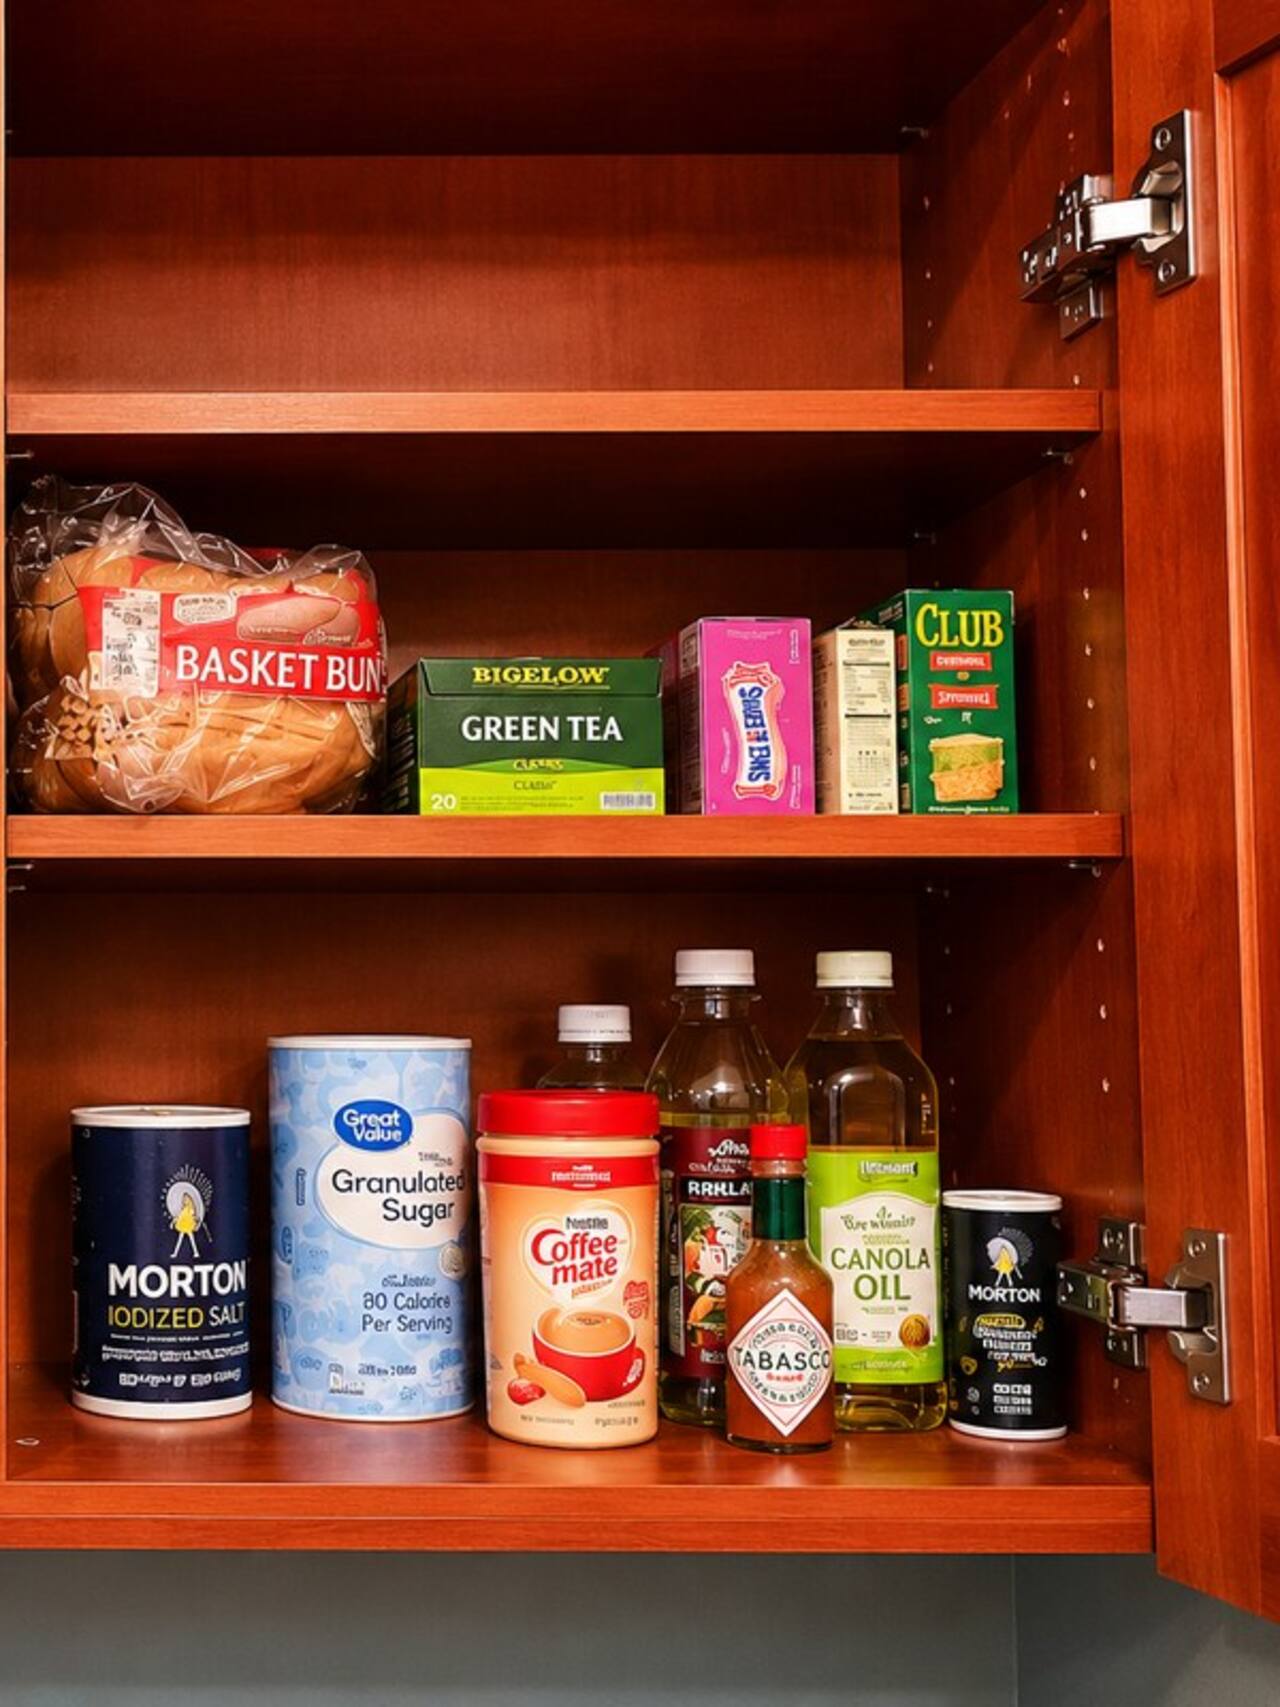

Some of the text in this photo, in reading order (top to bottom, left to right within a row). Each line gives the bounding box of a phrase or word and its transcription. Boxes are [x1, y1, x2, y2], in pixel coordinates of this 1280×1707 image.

[916, 603, 1004, 647] CLUB
[176, 645, 387, 694] BASKET BUN
[473, 667, 604, 685] BIGELOW
[461, 716, 622, 741] GREEN TEA
[431, 794, 457, 811] 20
[343, 1109, 400, 1127] Great
[353, 1125, 402, 1142] Value
[331, 1168, 465, 1194] Granulated
[382, 1197, 455, 1228] Sugar
[531, 1228, 617, 1266] Coffee
[831, 1248, 931, 1270] CANOLA
[108, 1259, 246, 1299] MORTON
[552, 1256, 617, 1286] mate
[853, 1274, 911, 1301] OIL
[968, 1284, 1040, 1302] MORTON
[108, 1302, 245, 1328] IODIZED SALT
[361, 1313, 453, 1334] Per Serving
[734, 1346, 830, 1370] TABASCO
